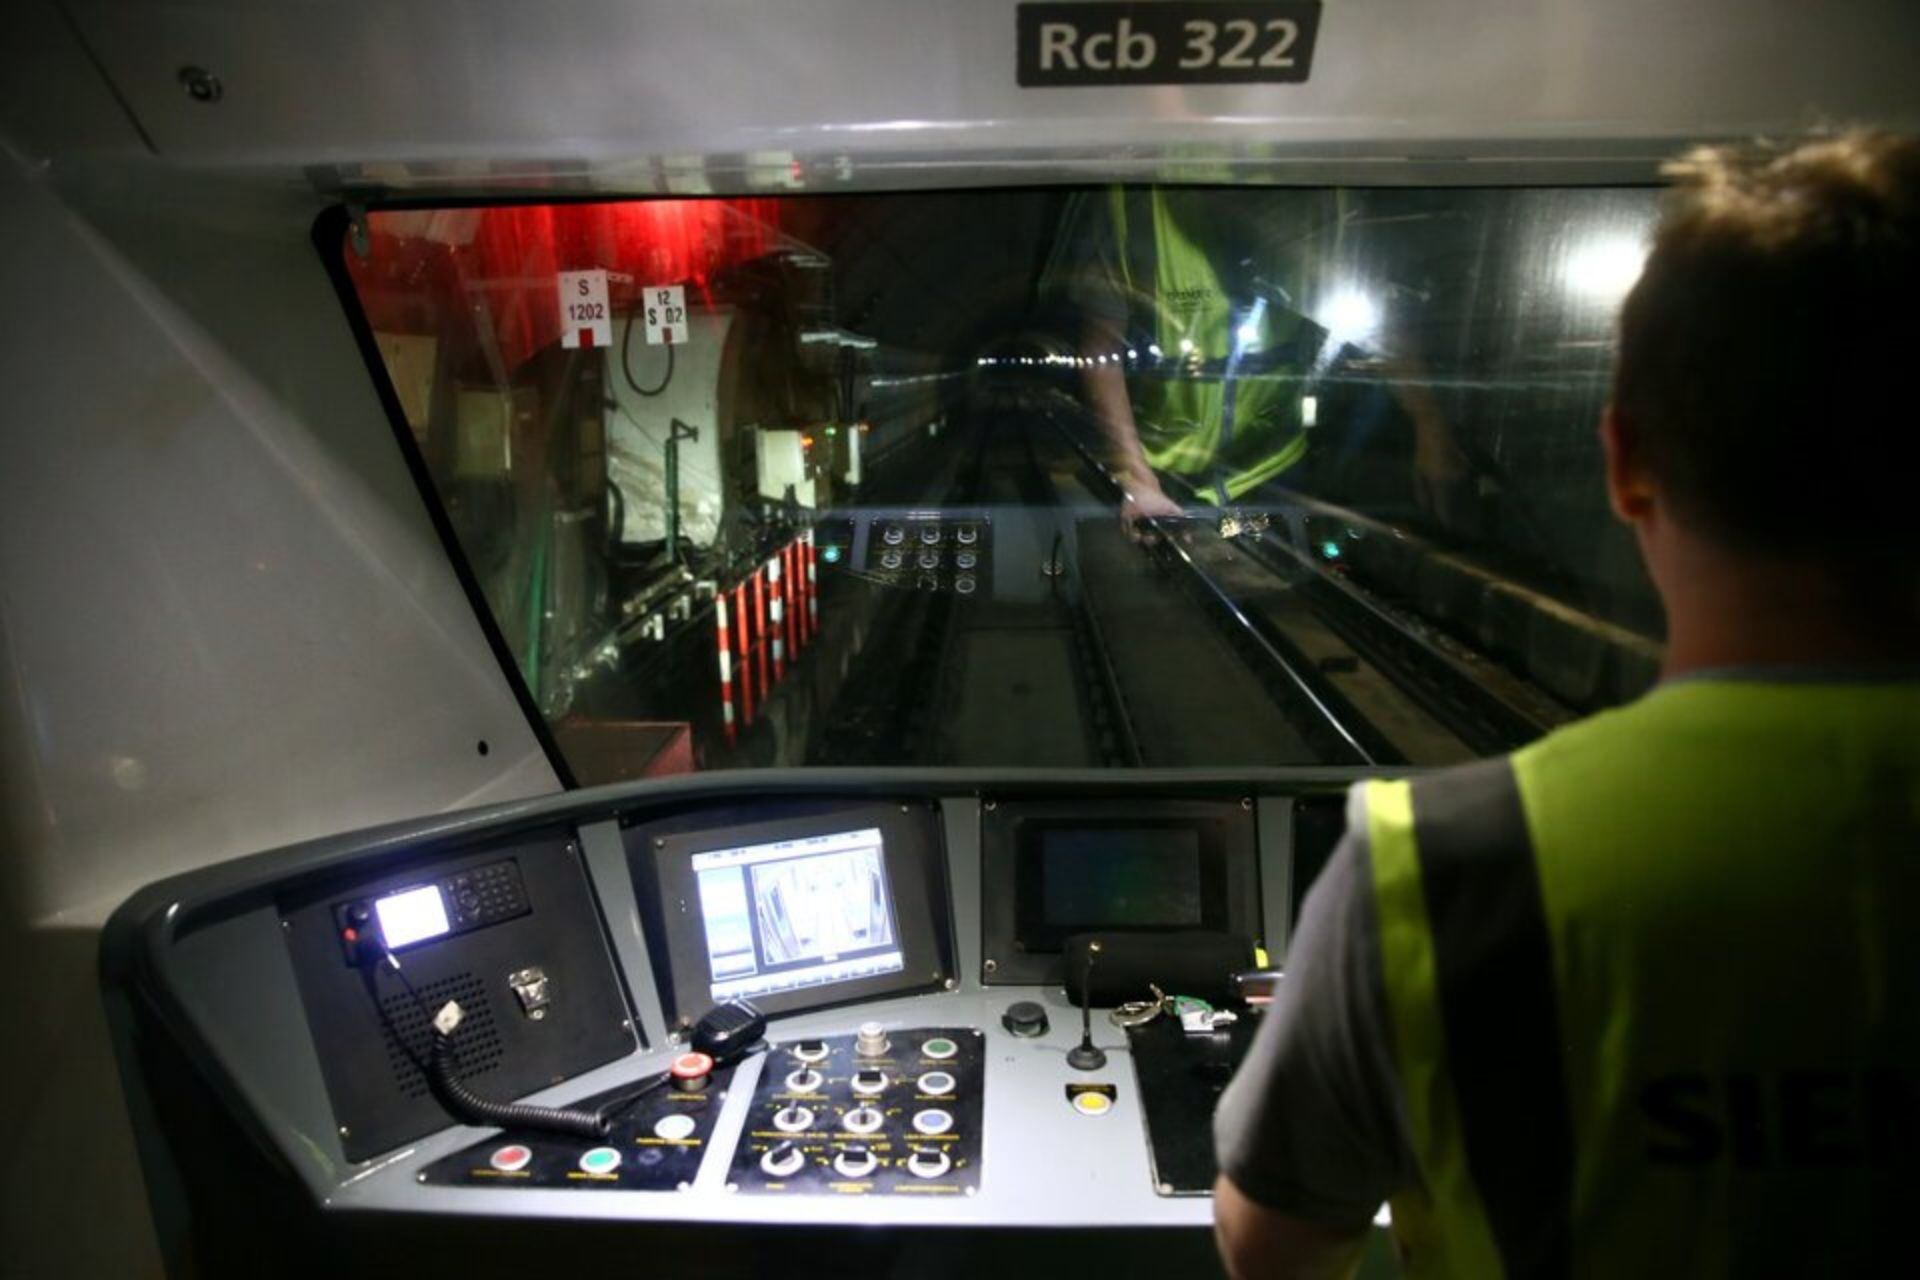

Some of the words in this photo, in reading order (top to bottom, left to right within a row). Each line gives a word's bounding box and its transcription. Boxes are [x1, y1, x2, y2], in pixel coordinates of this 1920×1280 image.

[1039, 18, 1157, 70] Rcb
[1178, 19, 1298, 68] 322
[577, 279, 590, 297] S
[657, 290, 671, 306] 12
[569, 303, 605, 321] 1202
[647, 308, 658, 326] S
